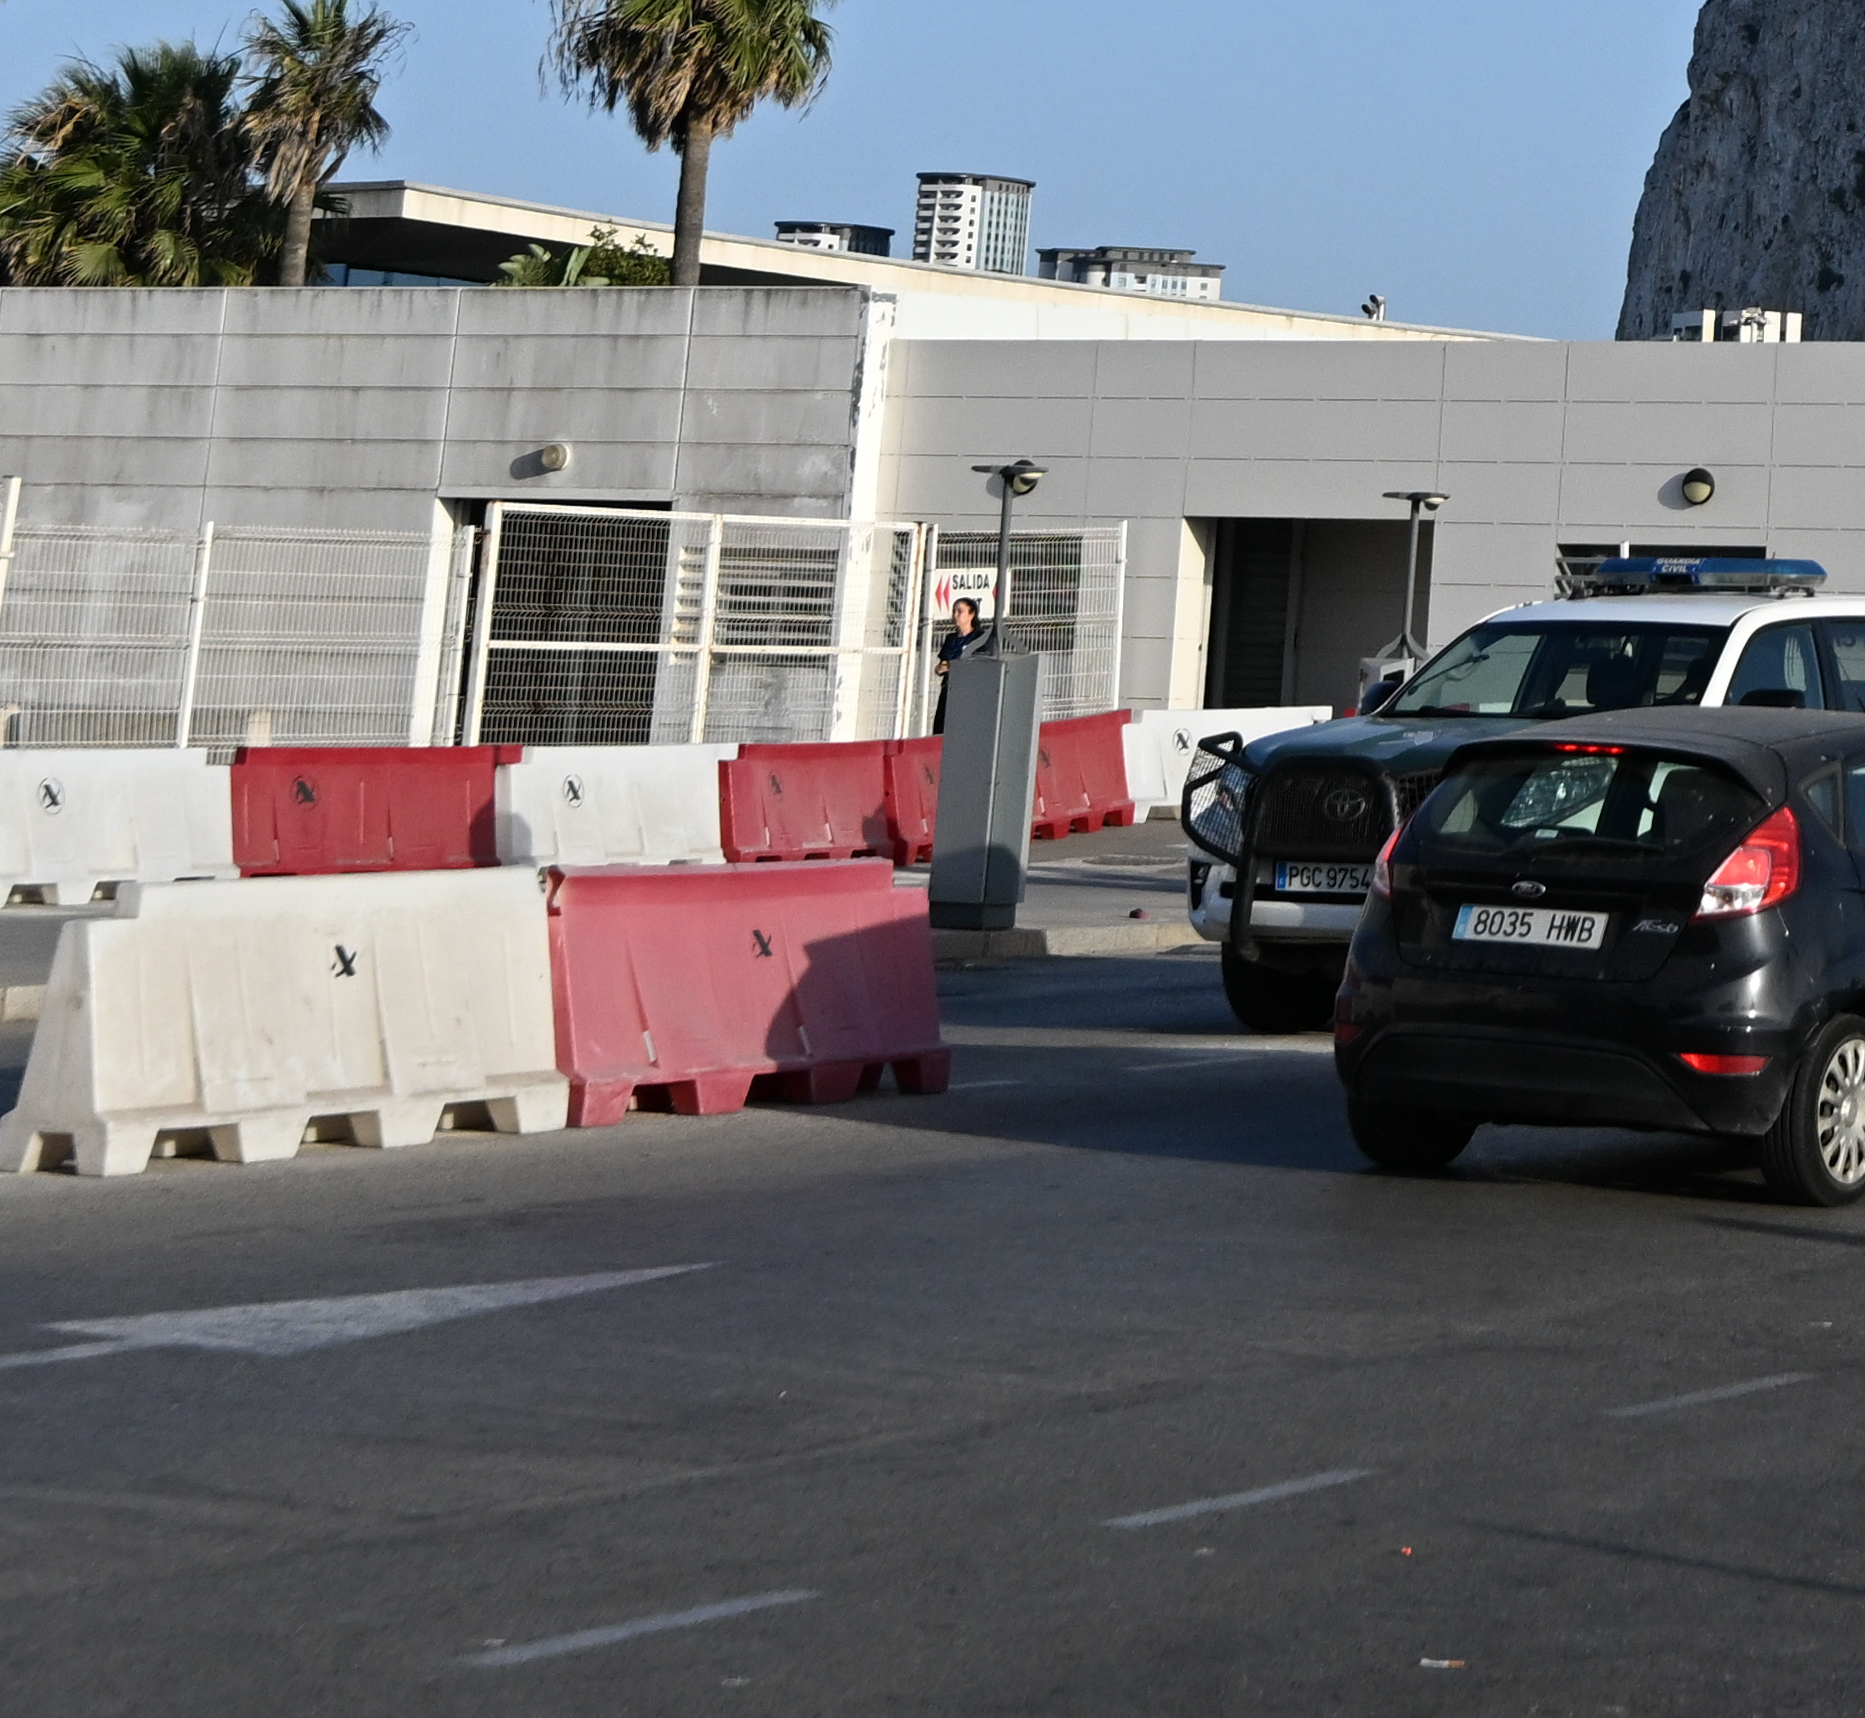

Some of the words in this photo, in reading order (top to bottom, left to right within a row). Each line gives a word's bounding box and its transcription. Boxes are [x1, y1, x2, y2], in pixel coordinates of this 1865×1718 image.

[1656, 557, 1701, 565] GUARDIA
[1661, 564, 1688, 573] CIVIL
[952, 573, 990, 590] SALIDA
[1288, 866, 1323, 888] PGC
[1326, 867, 1371, 889] 9754
[1473, 909, 1534, 938] 8035
[1546, 913, 1596, 944] HWB
